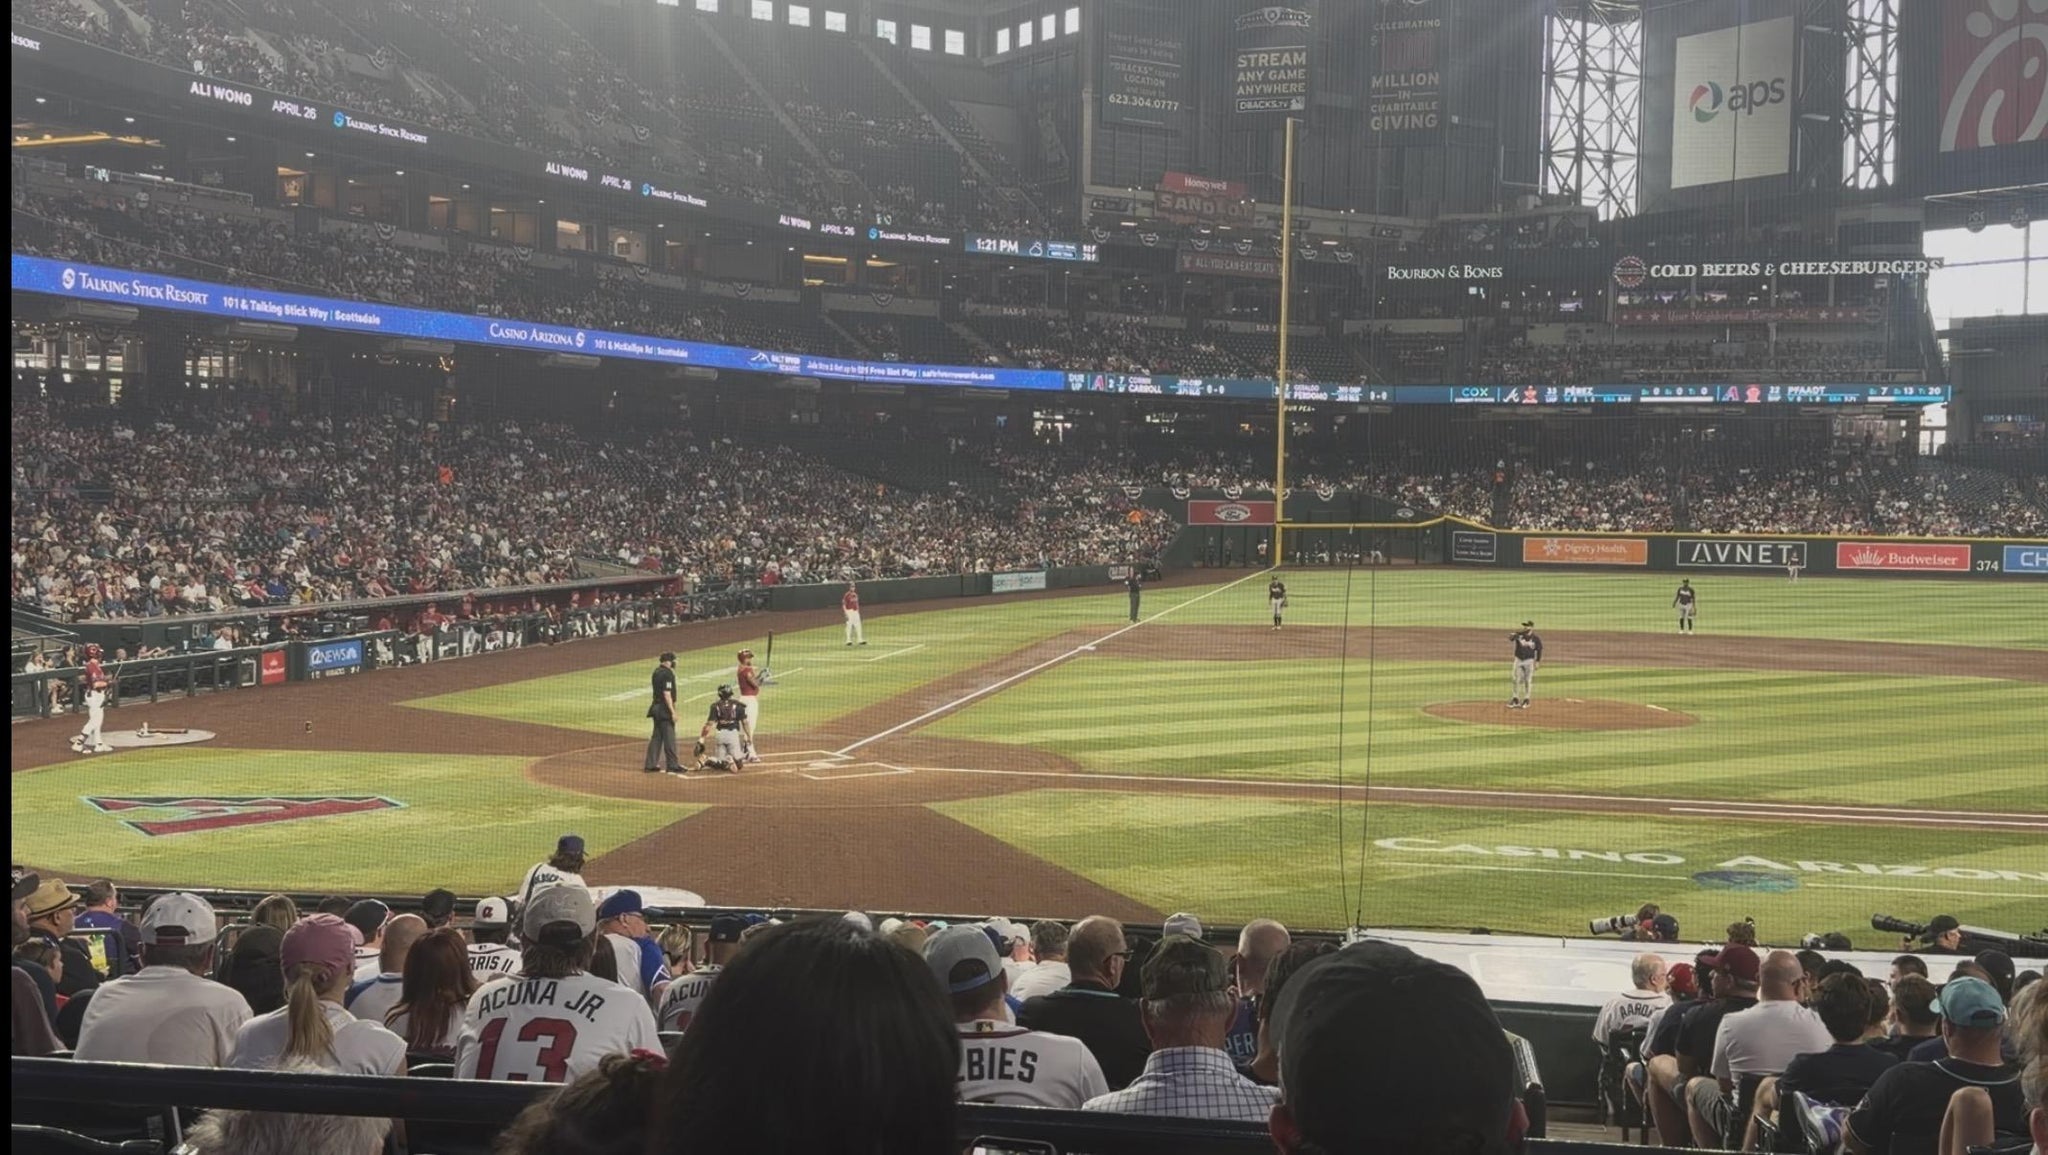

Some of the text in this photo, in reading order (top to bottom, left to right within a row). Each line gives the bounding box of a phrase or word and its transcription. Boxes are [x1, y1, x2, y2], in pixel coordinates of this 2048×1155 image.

[12, 32, 40, 51] ESORT
[1237, 52, 1306, 67] STREAM
[1237, 69, 1306, 82] ANY GAME
[1372, 72, 1439, 88] MILLION
[190, 82, 252, 106] ALI WONG
[1237, 83, 1306, 95] ANYWHERE
[1398, 90, 1411, 99] IN
[1727, 77, 1785, 116] aps
[1109, 93, 1179, 111] 623.304.0777
[1371, 101, 1438, 113] CHARITABLE
[272, 100, 317, 120] APRIL 26
[345, 117, 377, 133] TALKING
[1371, 114, 1438, 131] GIVING
[545, 162, 589, 181] ALI WONG
[601, 175, 622, 189] APRIL
[1184, 177, 1228, 191] Honeywell
[820, 224, 843, 235] APRIL
[976, 238, 1019, 253] 1:21 PM
[1388, 265, 1503, 279] BOURBON & BONES
[1650, 264, 1697, 278] COLD
[1702, 263, 1760, 277] BEERS
[1764, 263, 1776, 276] &
[1780, 260, 1943, 276] CHEESEBURGERS
[79, 272, 209, 305] TALKING STICK RESORT
[223, 296, 381, 325] 101 & Talking Stick Way Scottsdale
[489, 323, 573, 346] CASINO ARIZONA
[1128, 385, 1163, 394] CARROLL
[1461, 387, 1488, 397] COX
[1881, 387, 1888, 395] 7
[1904, 387, 1914, 395] 13
[1928, 387, 1941, 395] 20
[1564, 543, 1627, 555] Dignity Health
[1691, 543, 1793, 563] AVNET
[1888, 553, 1959, 566] Budweiser
[1976, 560, 1999, 572] 374
[2020, 551, 2048, 567] CH
[1374, 838, 2048, 881] CASINO ARIZON
[468, 956, 500, 971] RRIS
[478, 980, 606, 1023] ACUNA JR.
[475, 1017, 577, 1082] 13
